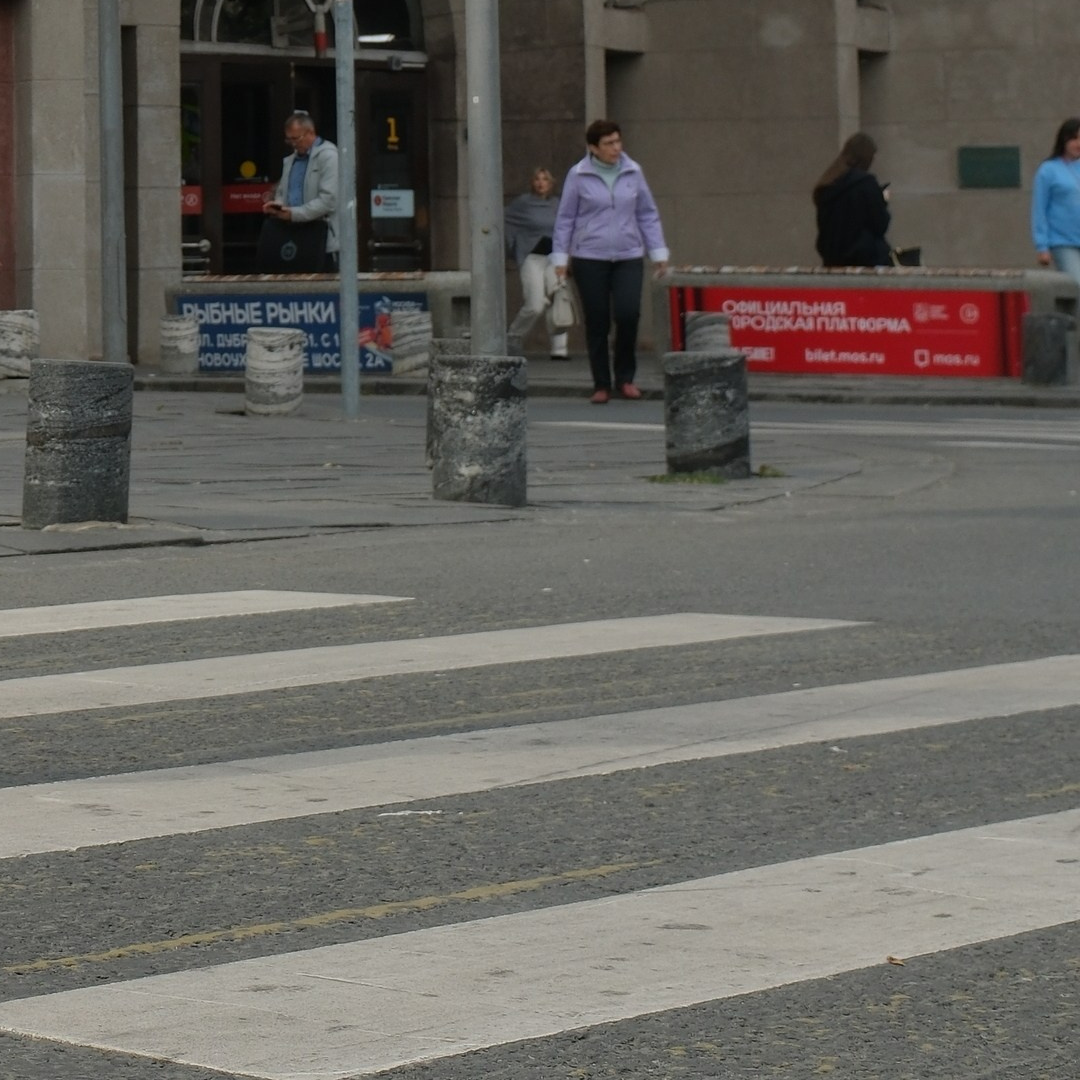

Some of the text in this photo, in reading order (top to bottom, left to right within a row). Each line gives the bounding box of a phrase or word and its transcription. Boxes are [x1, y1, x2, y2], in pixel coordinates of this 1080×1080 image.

[386, 117, 400, 142] 1
[266, 301, 336, 324] РЫНКИ
[722, 299, 846, 316] ОФИЦИАЛЬНАЯ
[816, 317, 911, 333] ПЛАТФОРМА
[366, 353, 385, 367] 2А
[805, 348, 885, 364] bilet.mos.ru
[933, 353, 980, 366] mos.ru
